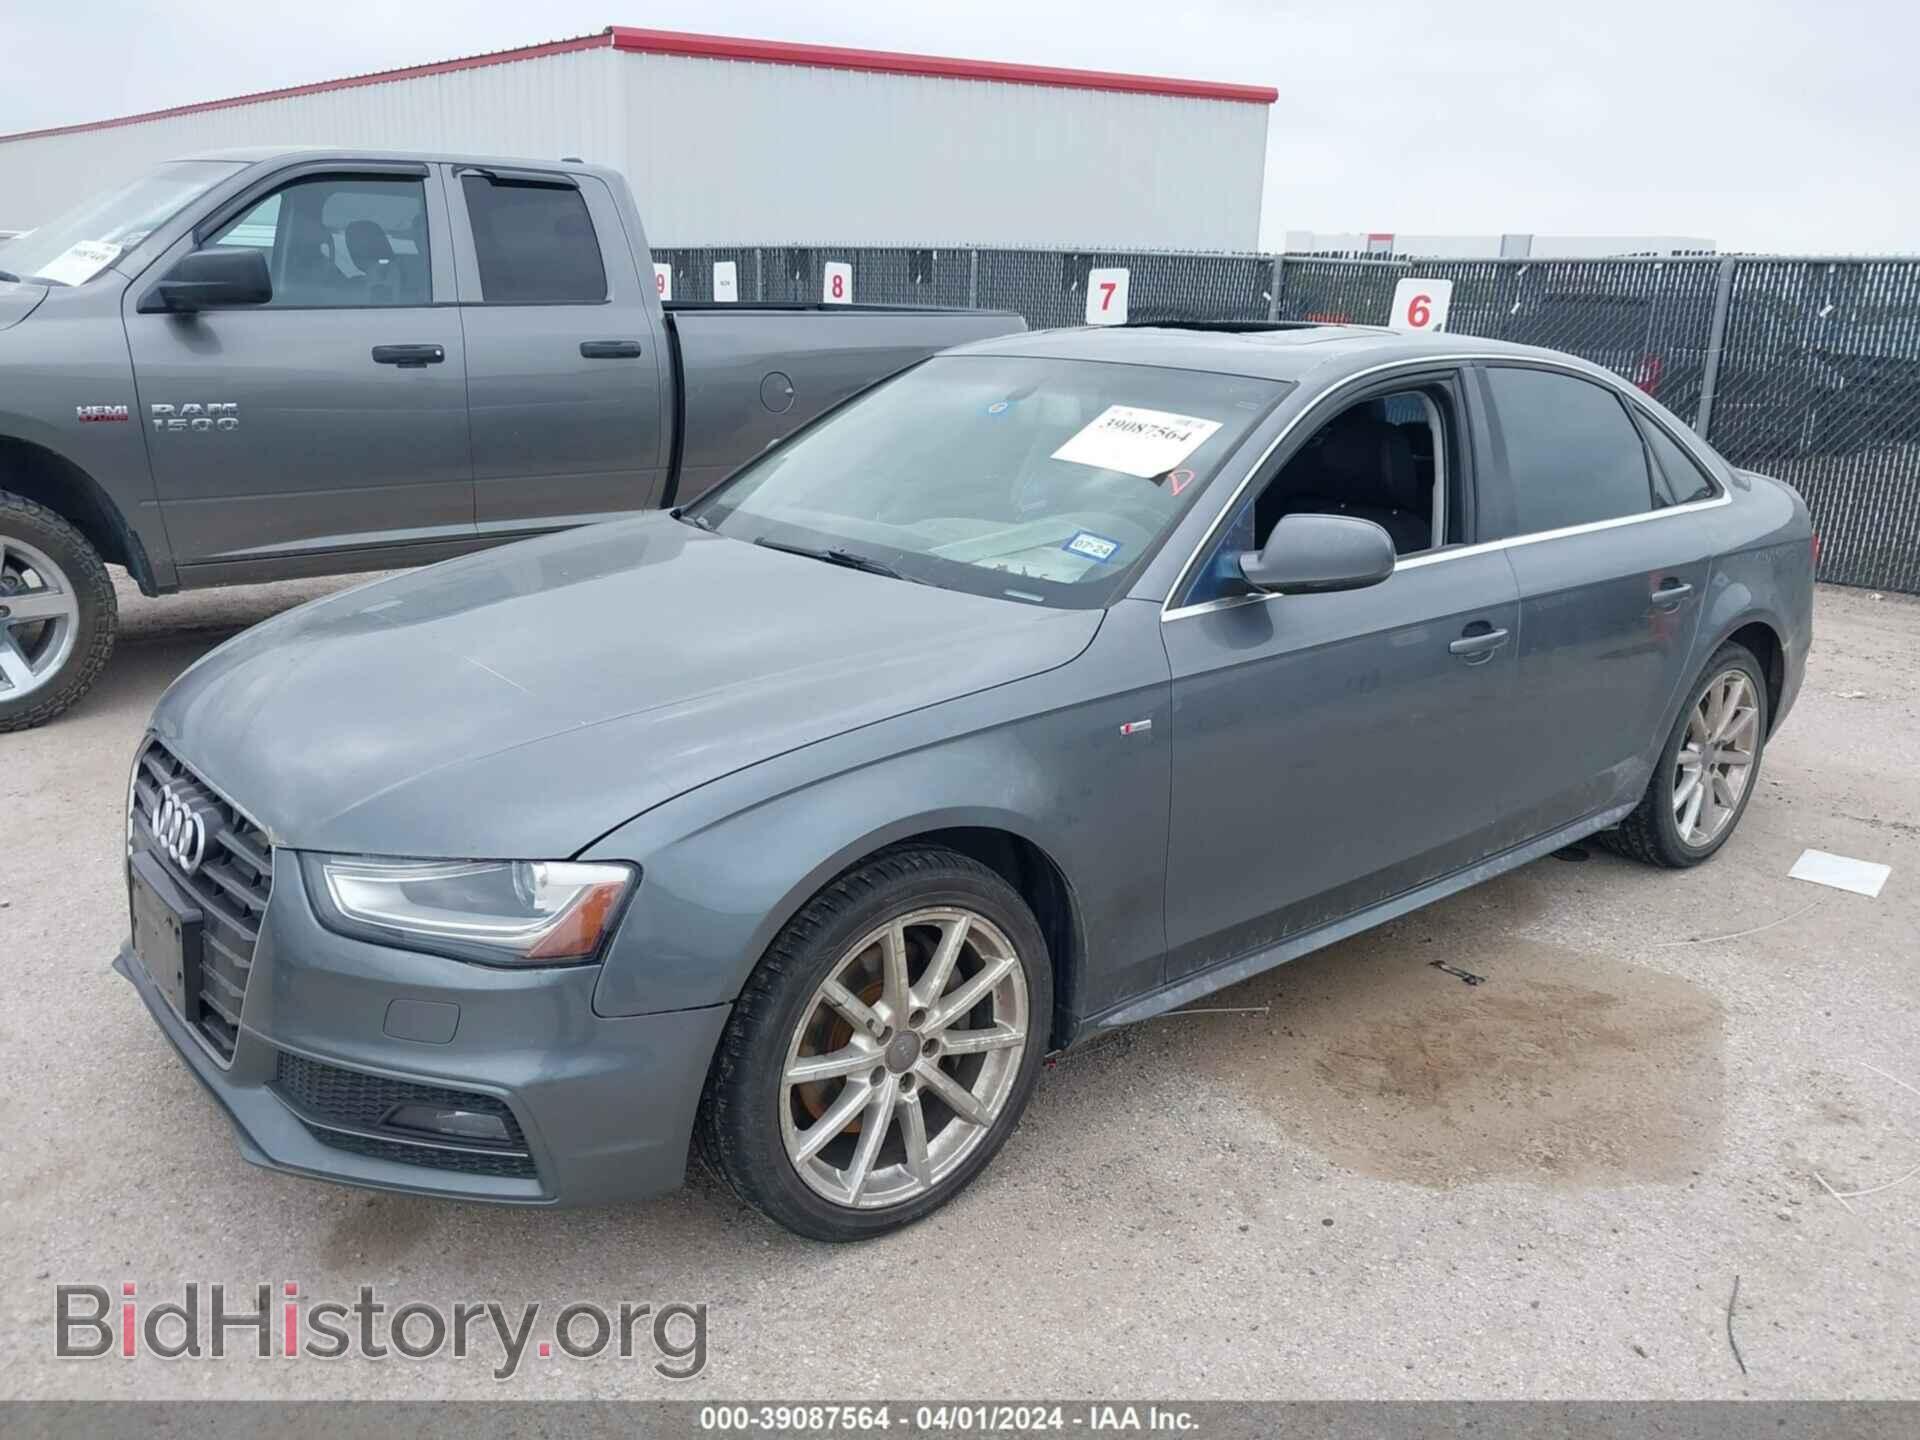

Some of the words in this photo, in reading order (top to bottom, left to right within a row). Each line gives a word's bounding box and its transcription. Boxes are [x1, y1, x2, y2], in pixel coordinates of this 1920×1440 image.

[656, 274, 665, 294] 9
[832, 275, 843, 298] 8
[1100, 283, 1116, 311] 7
[1408, 295, 1431, 327] 6
[76, 405, 128, 415] HEMI
[151, 403, 237, 416] RAM
[153, 418, 239, 432] 1500
[1104, 417, 1193, 443] 39087564
